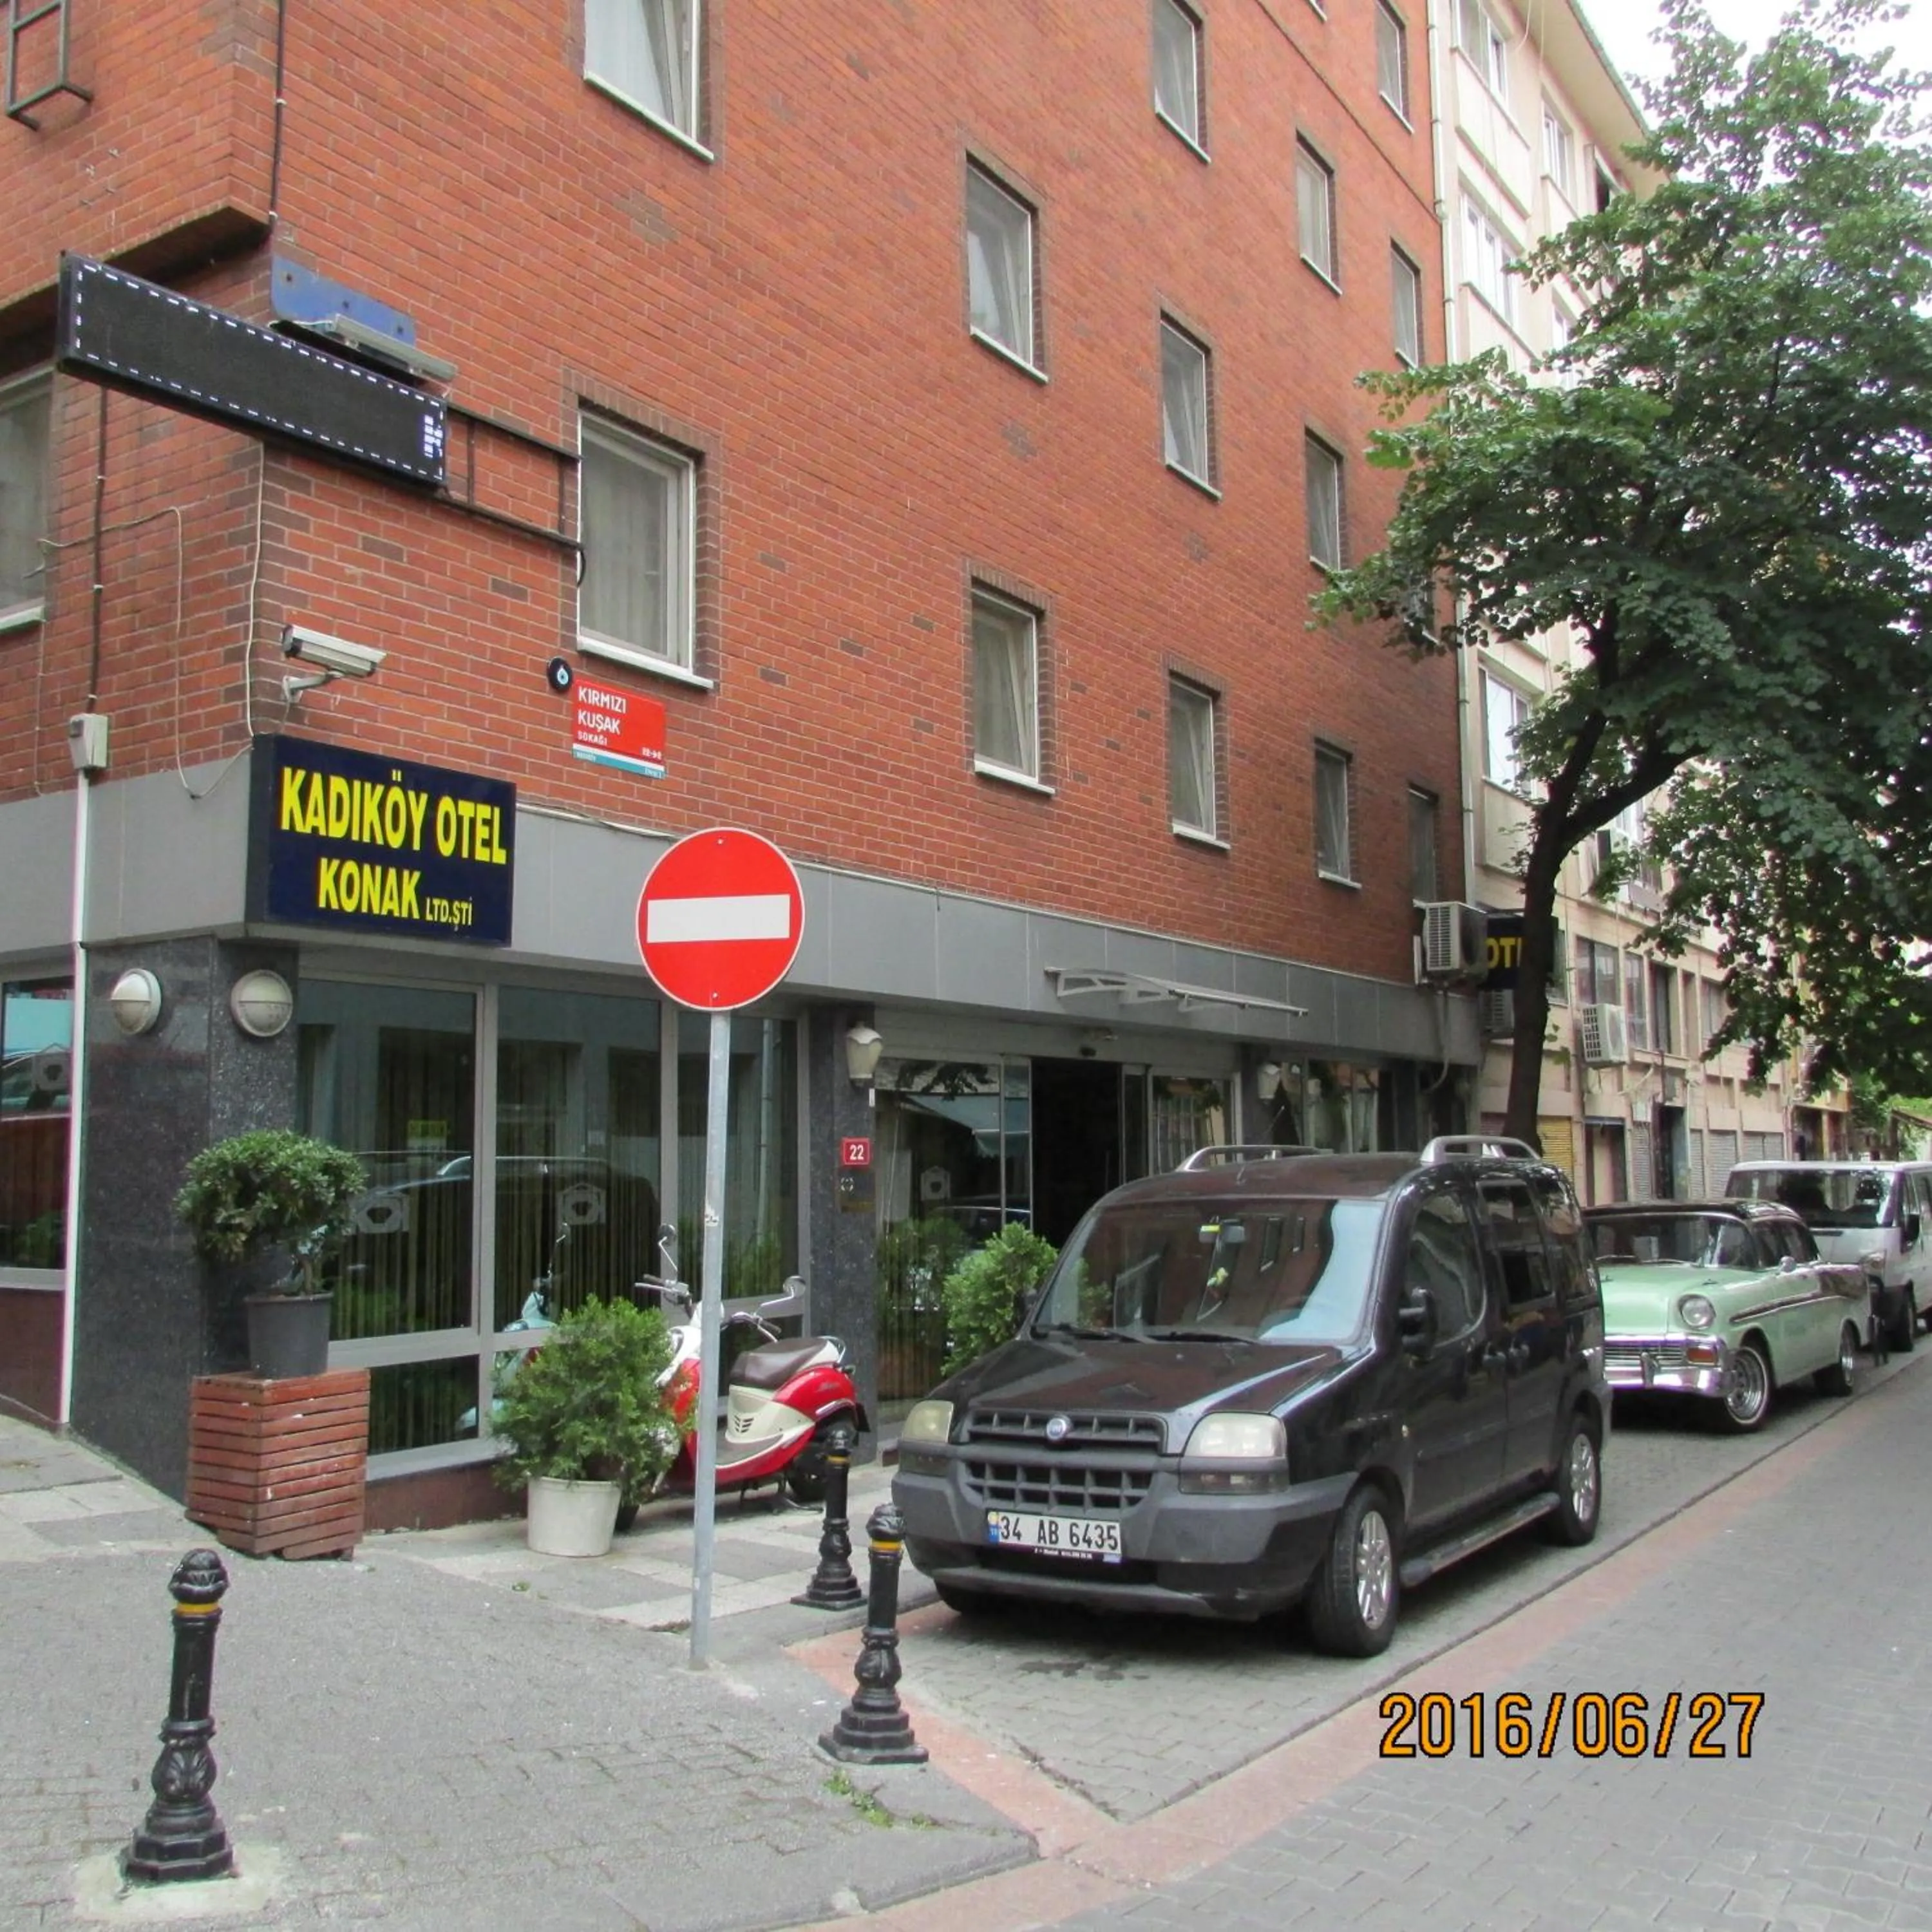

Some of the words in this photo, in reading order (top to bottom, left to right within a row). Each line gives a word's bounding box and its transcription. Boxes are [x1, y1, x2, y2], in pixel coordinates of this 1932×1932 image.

[578, 686, 627, 714] KIRMIZI
[578, 710, 621, 735] KUŞAK
[281, 766, 428, 851] KADIKÖY
[436, 795, 507, 864] OTEL
[319, 857, 421, 919] KONAK
[849, 1144, 864, 1160] 22
[1001, 1515, 1022, 1541] 34
[1037, 1519, 1059, 1545] AB
[1069, 1522, 1119, 1551] 6435
